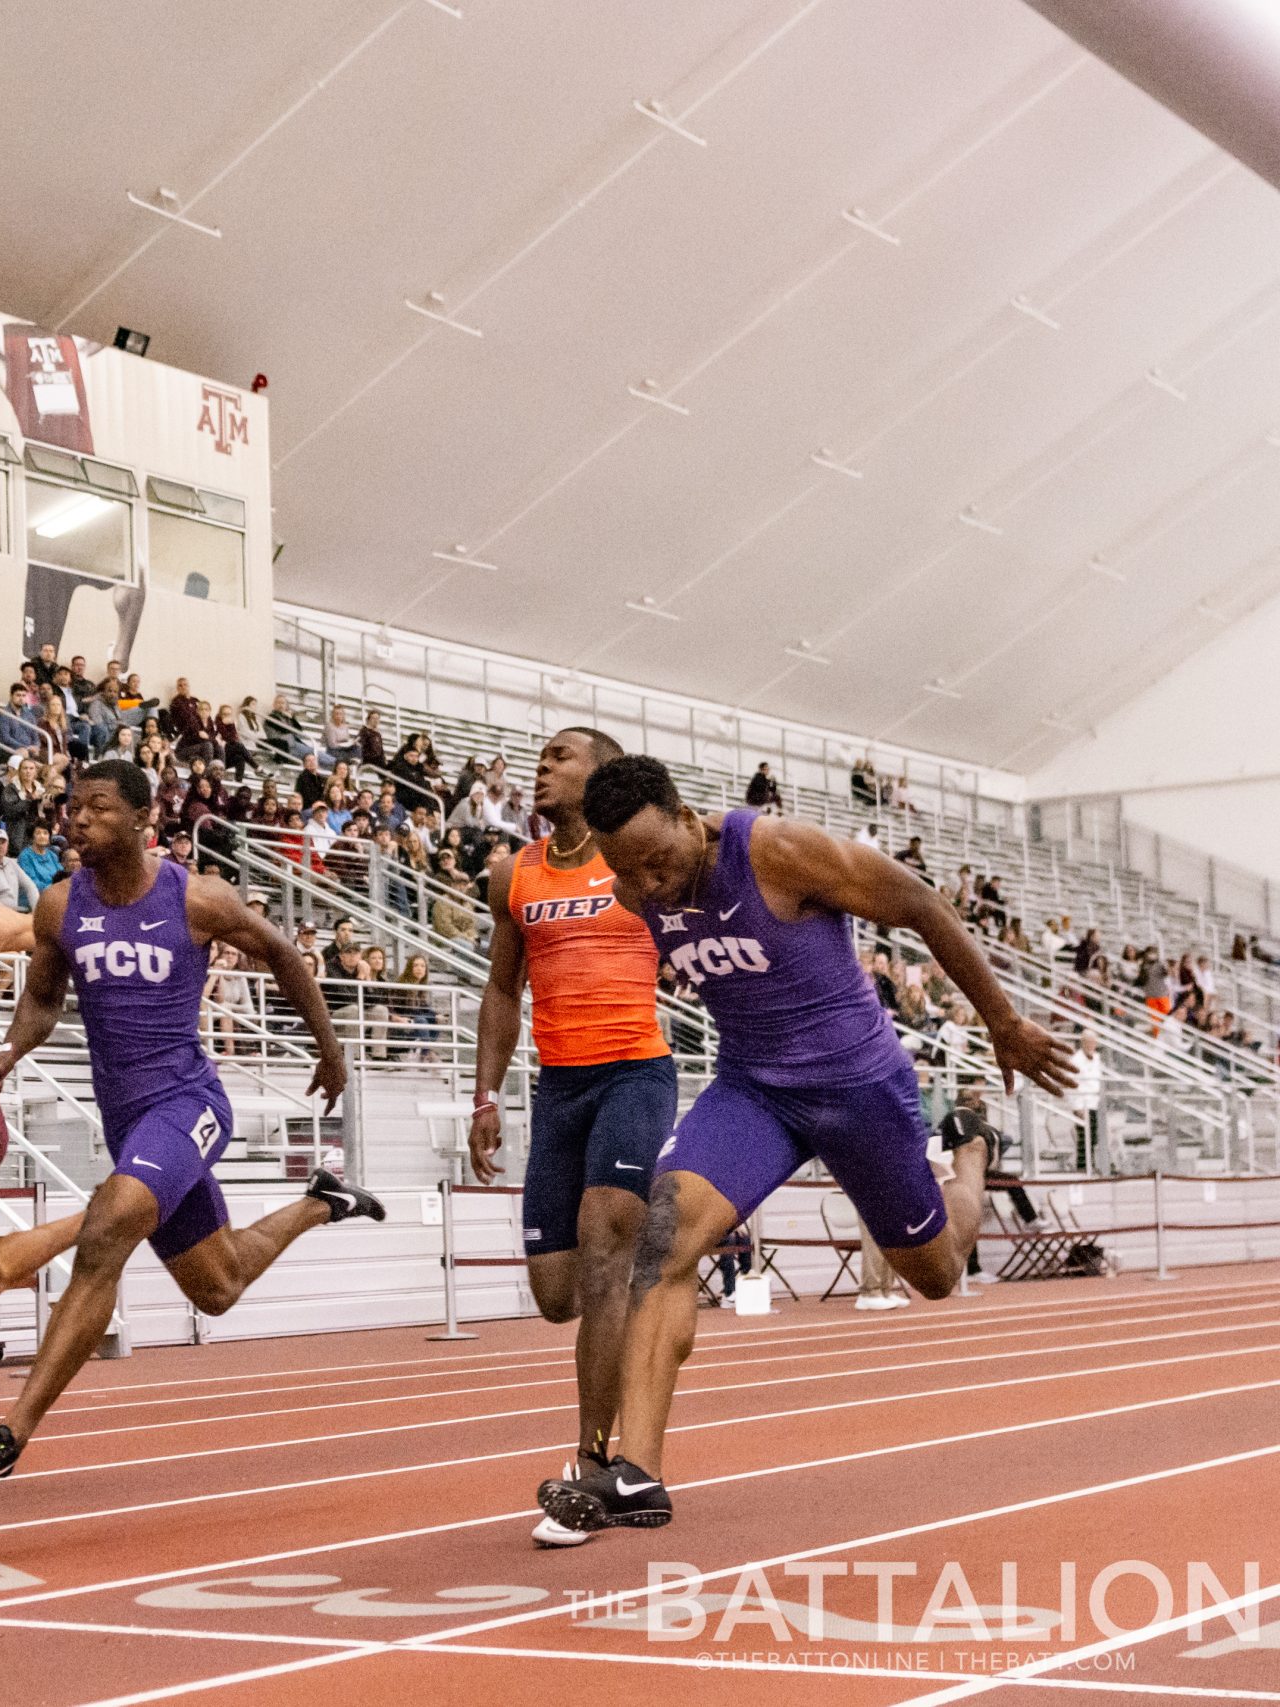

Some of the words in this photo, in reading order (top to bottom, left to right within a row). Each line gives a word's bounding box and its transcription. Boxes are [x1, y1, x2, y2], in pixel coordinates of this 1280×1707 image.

[523, 894, 616, 926] UTEP
[75, 940, 174, 983] TCU
[670, 936, 770, 986] TCU
[199, 1121, 216, 1150] 4
[134, 1574, 551, 1617] 3
